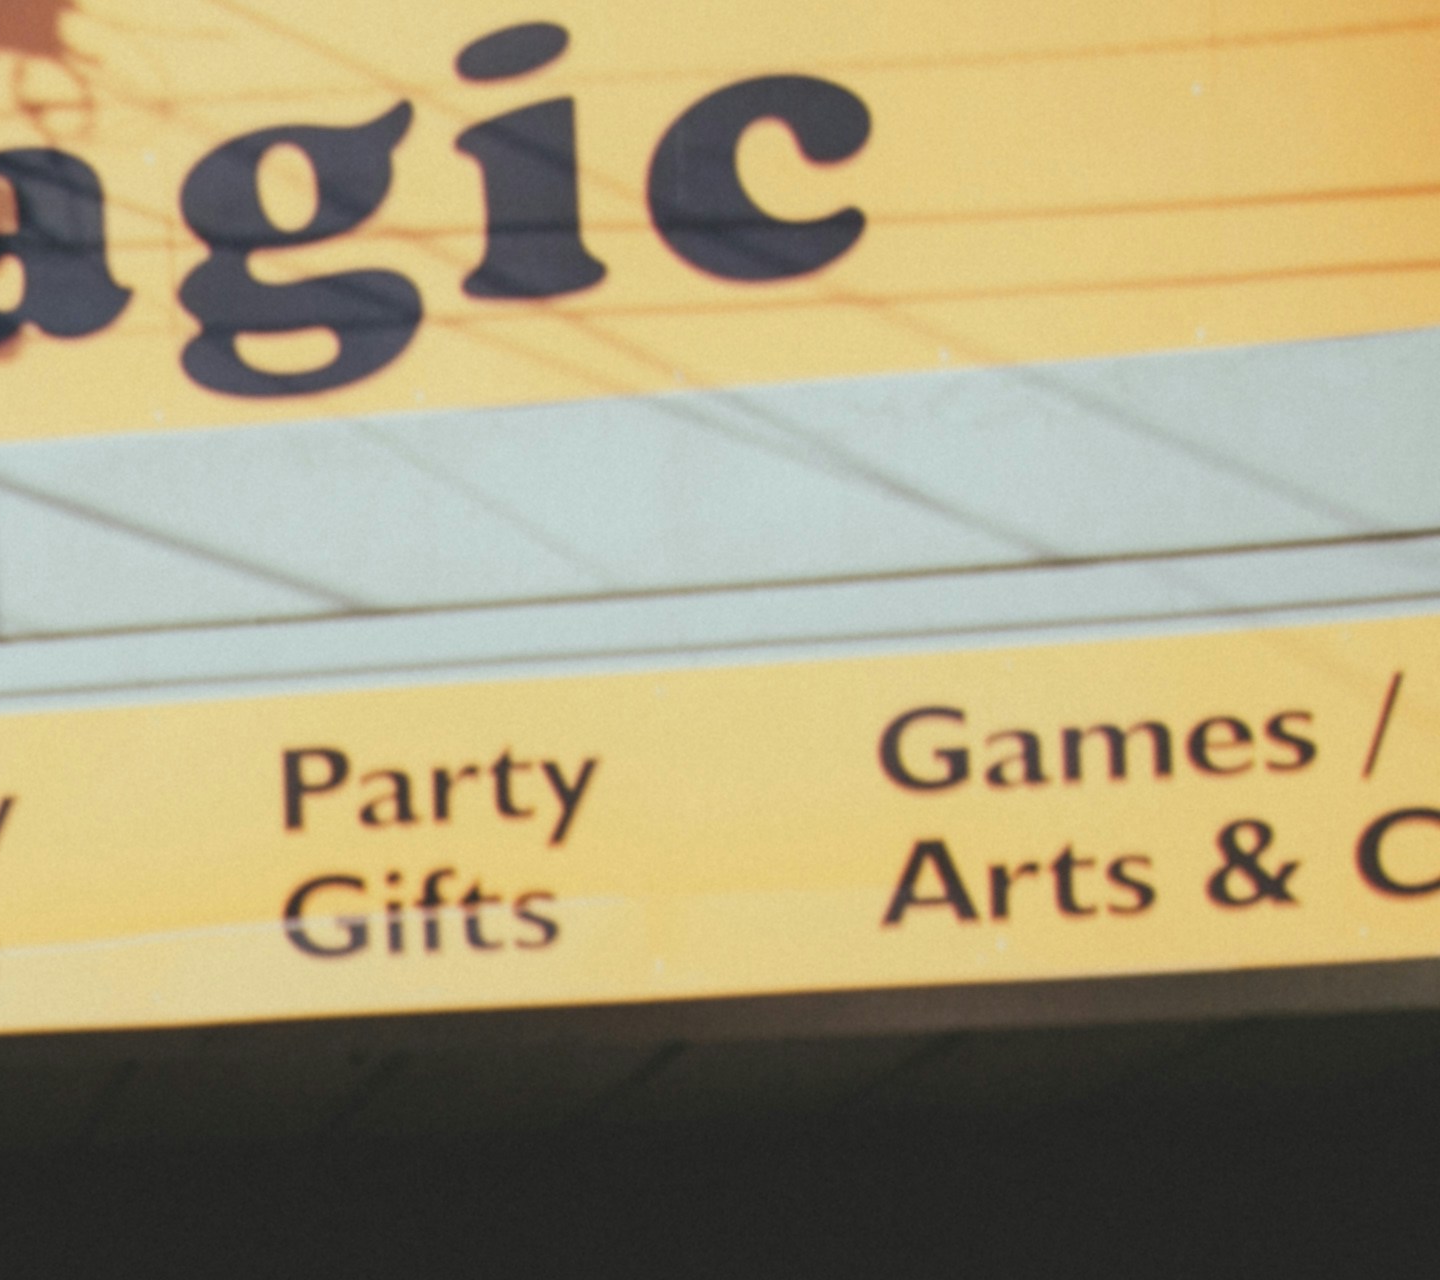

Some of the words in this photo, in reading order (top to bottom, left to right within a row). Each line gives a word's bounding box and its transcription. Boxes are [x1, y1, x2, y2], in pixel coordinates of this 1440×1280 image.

[280, 744, 601, 846] Party
[879, 703, 1319, 793] Games
[283, 870, 560, 961] Gifts
[881, 838, 1157, 931] Arts
[1205, 818, 1301, 911] &
